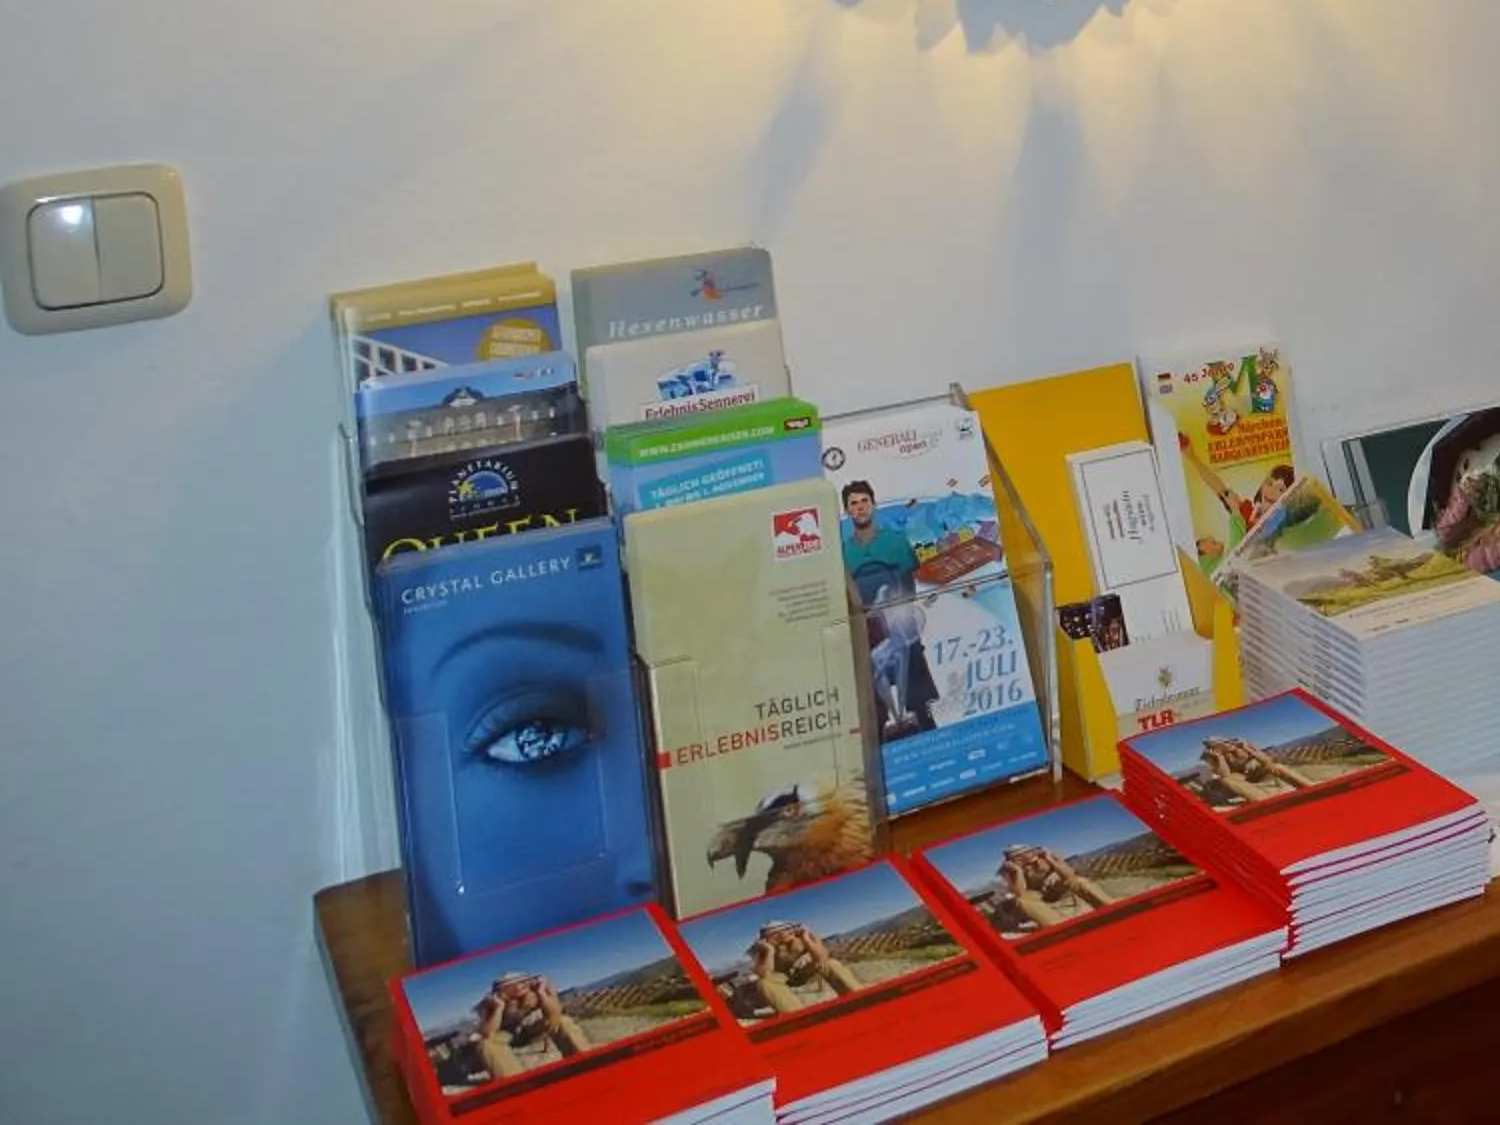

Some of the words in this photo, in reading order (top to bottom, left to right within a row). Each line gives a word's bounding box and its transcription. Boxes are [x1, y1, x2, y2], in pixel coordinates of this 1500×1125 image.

[608, 303, 763, 338] Hexenwasser
[857, 429, 918, 453] GENERALI
[400, 575, 484, 605] CRYSTAL
[489, 555, 571, 585] GALLERY
[965, 650, 1018, 690] JULI
[754, 687, 840, 722] TÄGLICH
[963, 678, 1023, 717] 2016
[676, 709, 842, 766] ERLEBNISREICH
